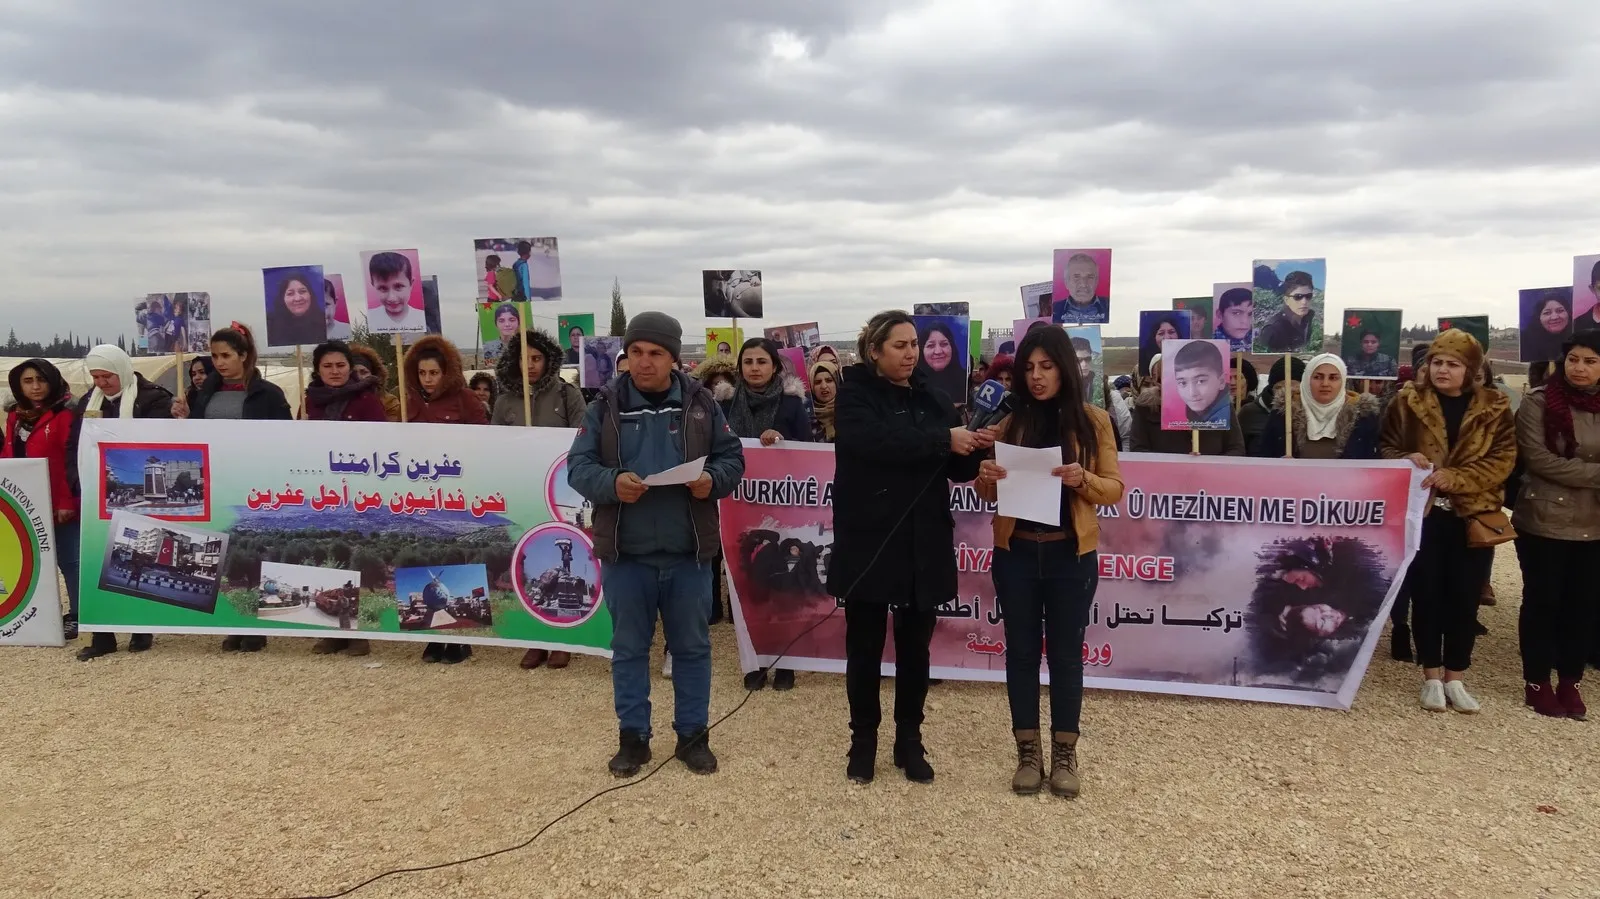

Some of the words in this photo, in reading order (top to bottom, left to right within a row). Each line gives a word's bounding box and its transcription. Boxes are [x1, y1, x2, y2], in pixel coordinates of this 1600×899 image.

[980, 384, 995, 402] R
[328, 450, 400, 479] كرامتنا
[406, 453, 462, 481] عفرين
[1, 477, 35, 515] KANTONA
[247, 482, 305, 510] عفرين
[311, 477, 349, 511] أجل
[353, 490, 383, 513] من
[389, 486, 466, 515] فدائيون
[471, 491, 506, 517] نحن
[1127, 488, 1145, 519] Û
[1259, 497, 1296, 524] ME
[1097, 553, 1175, 581] ENGE
[1106, 603, 1155, 629] تحتل
